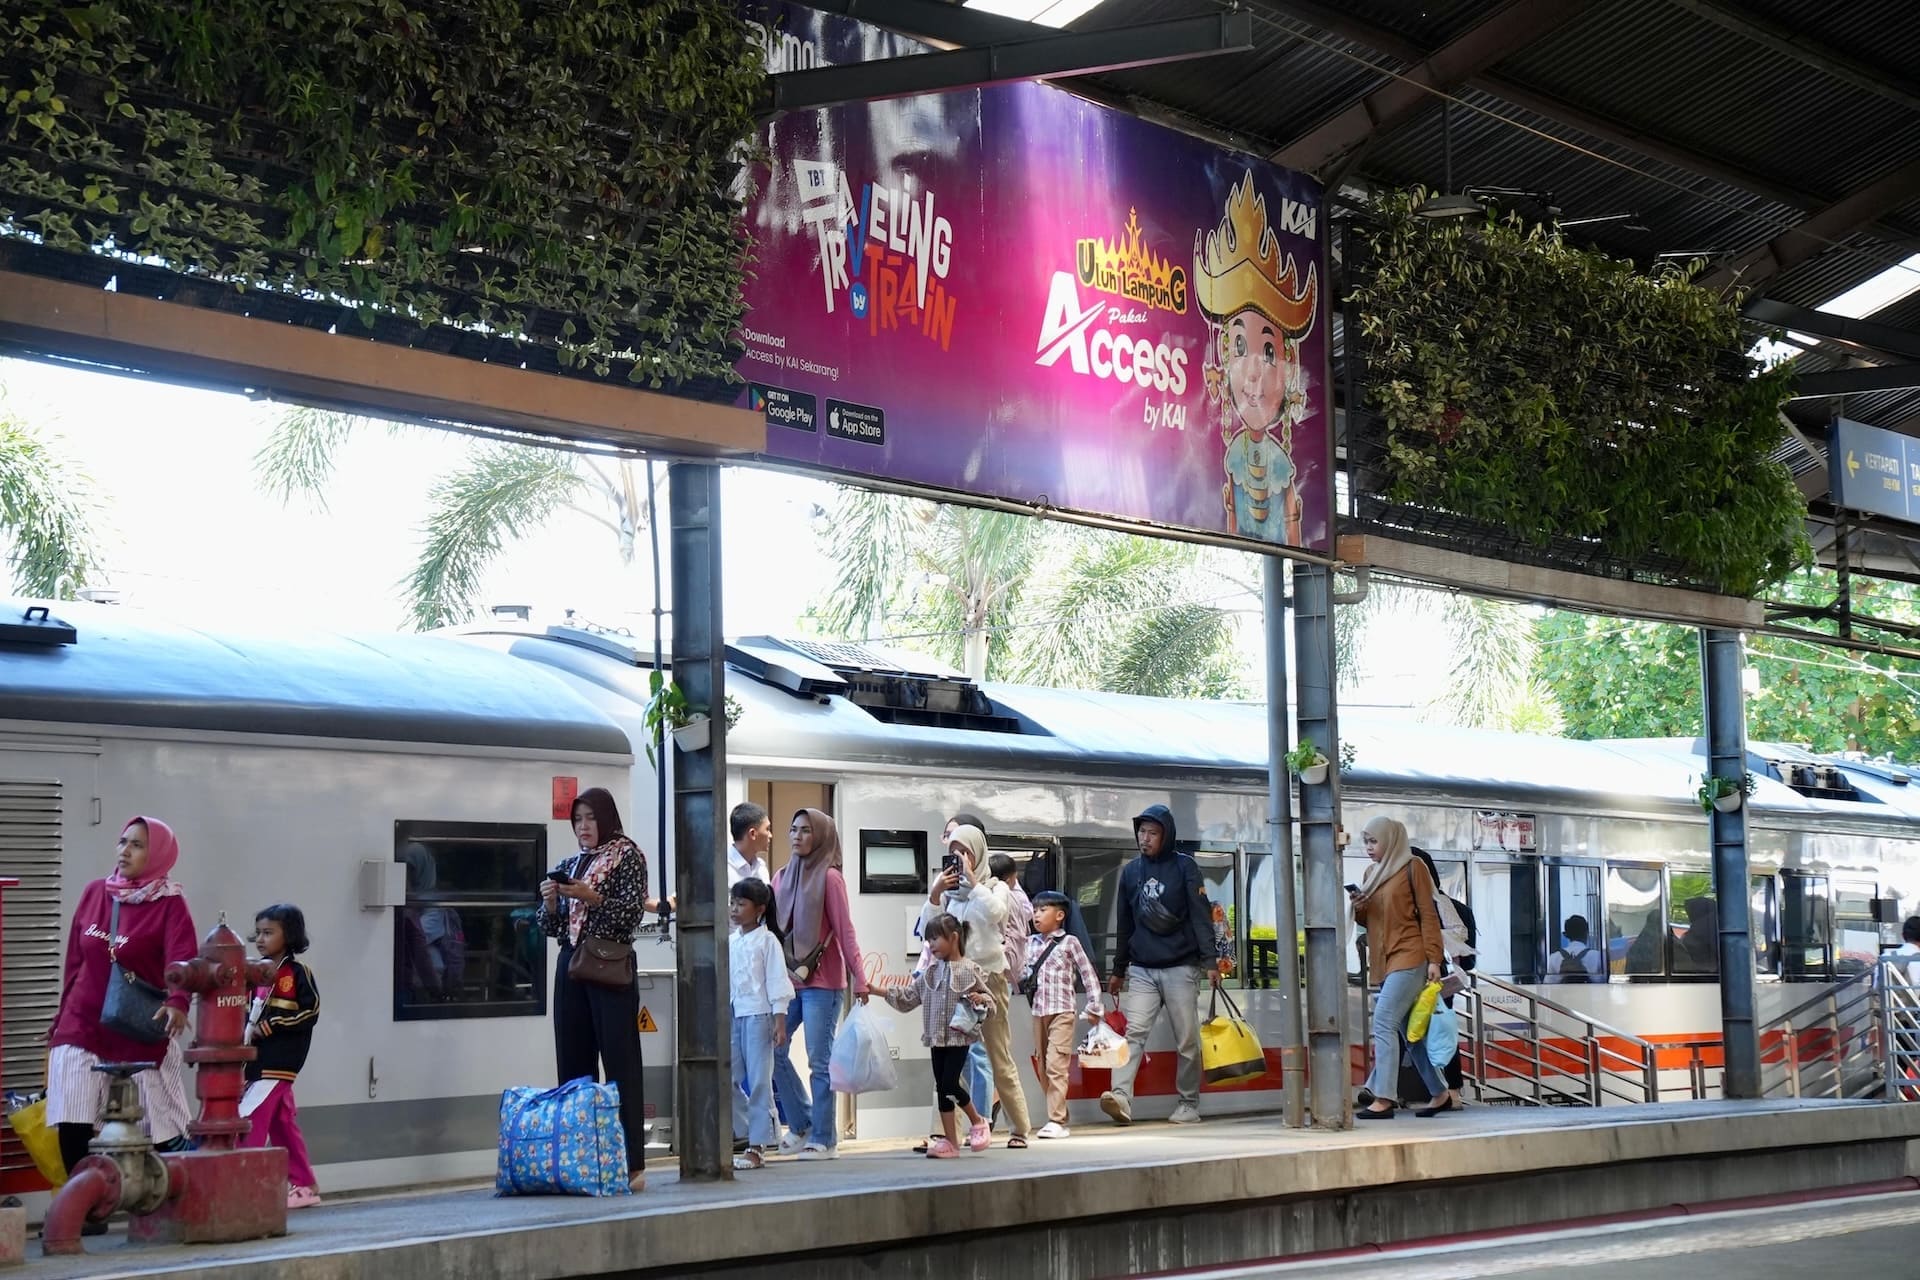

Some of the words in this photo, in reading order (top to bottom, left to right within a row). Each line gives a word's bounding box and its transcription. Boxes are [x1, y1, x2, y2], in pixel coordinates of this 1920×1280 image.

[1280, 197, 1316, 240] KAI
[853, 291, 866, 311] by
[1108, 307, 1148, 325] Pakai
[745, 328, 785, 348] Download
[1035, 270, 1188, 395] Access
[746, 348, 773, 364] Access
[775, 353, 784, 369] by
[786, 357, 798, 369] KAI
[767, 402, 795, 422] Google
[796, 408, 813, 427] Play
[1144, 397, 1160, 431] by
[1162, 402, 1186, 430] KAI
[842, 418, 858, 436] App
[859, 421, 881, 438] Store
[864, 952, 913, 987] Premi
[217, 995, 247, 1008] HYDR
